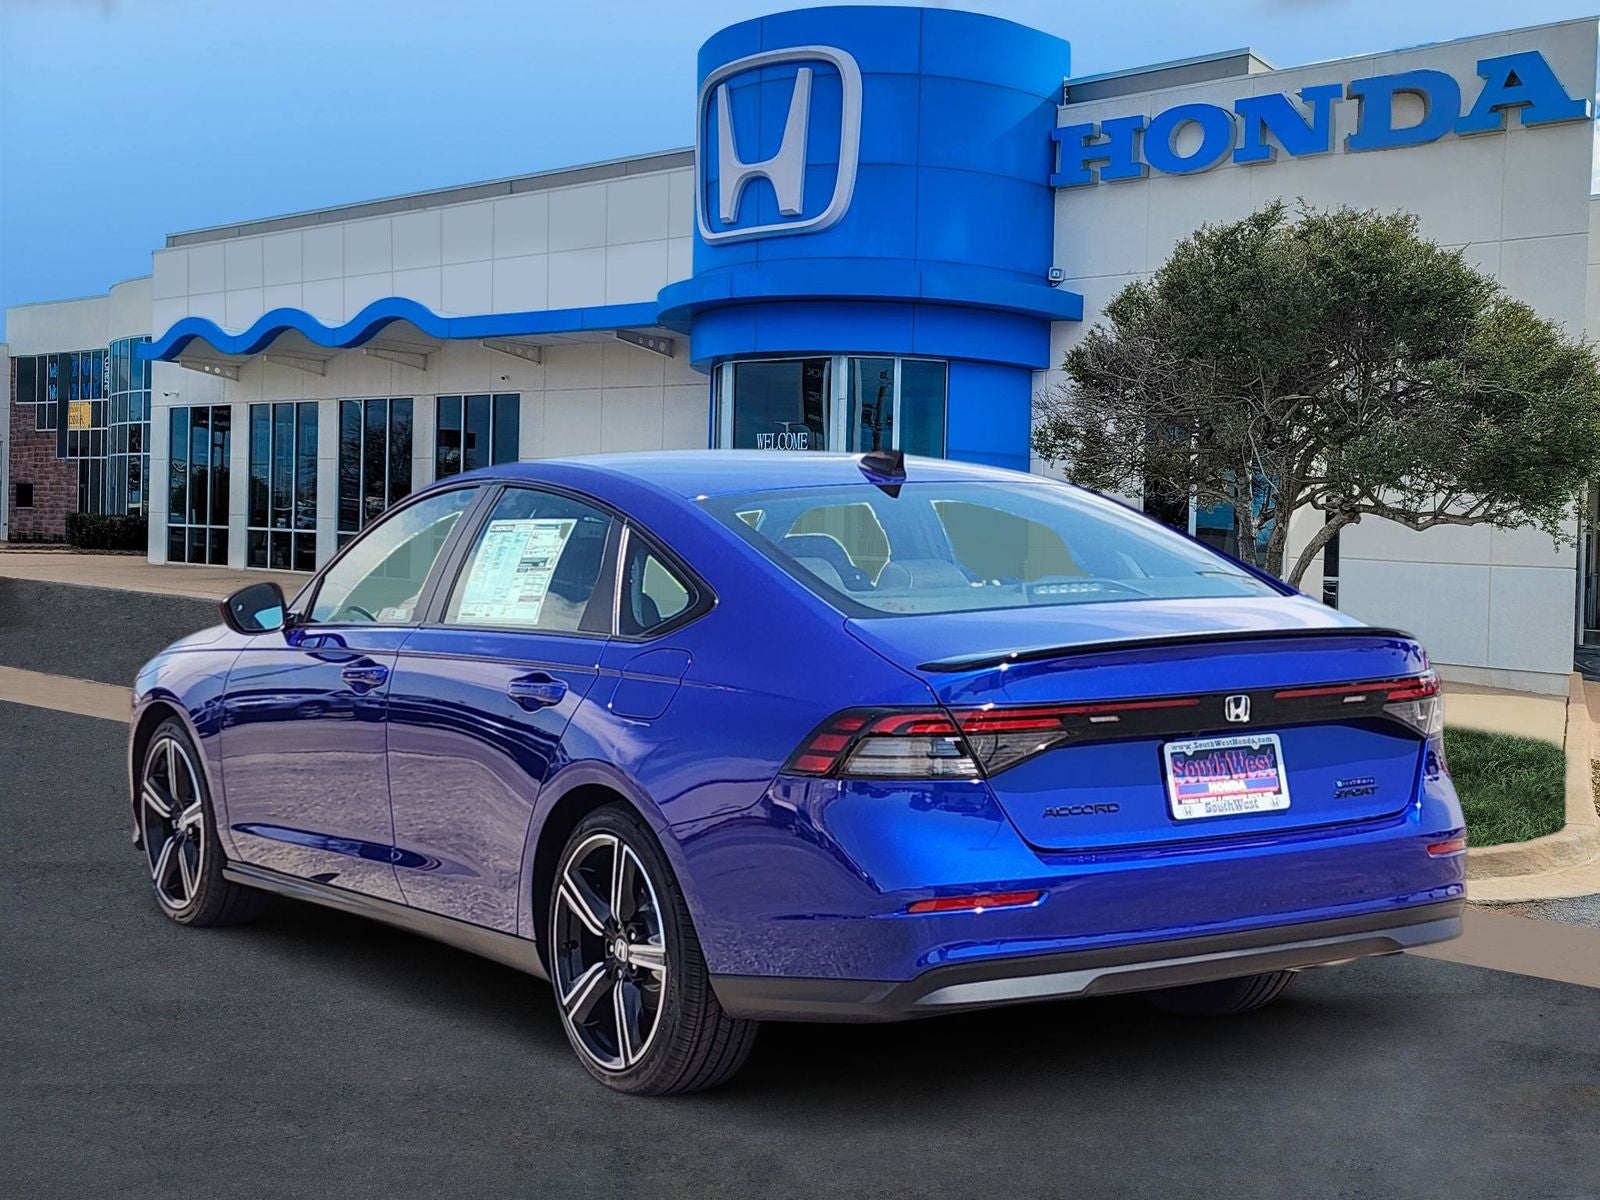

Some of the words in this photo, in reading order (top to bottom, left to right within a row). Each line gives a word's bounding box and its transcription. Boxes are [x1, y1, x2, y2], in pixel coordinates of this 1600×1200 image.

[1051, 50, 1592, 188] HONDA
[756, 432, 808, 450] WELCOME
[1042, 803, 1120, 818] ACCORD
[1205, 798, 1260, 814] SouthWest
